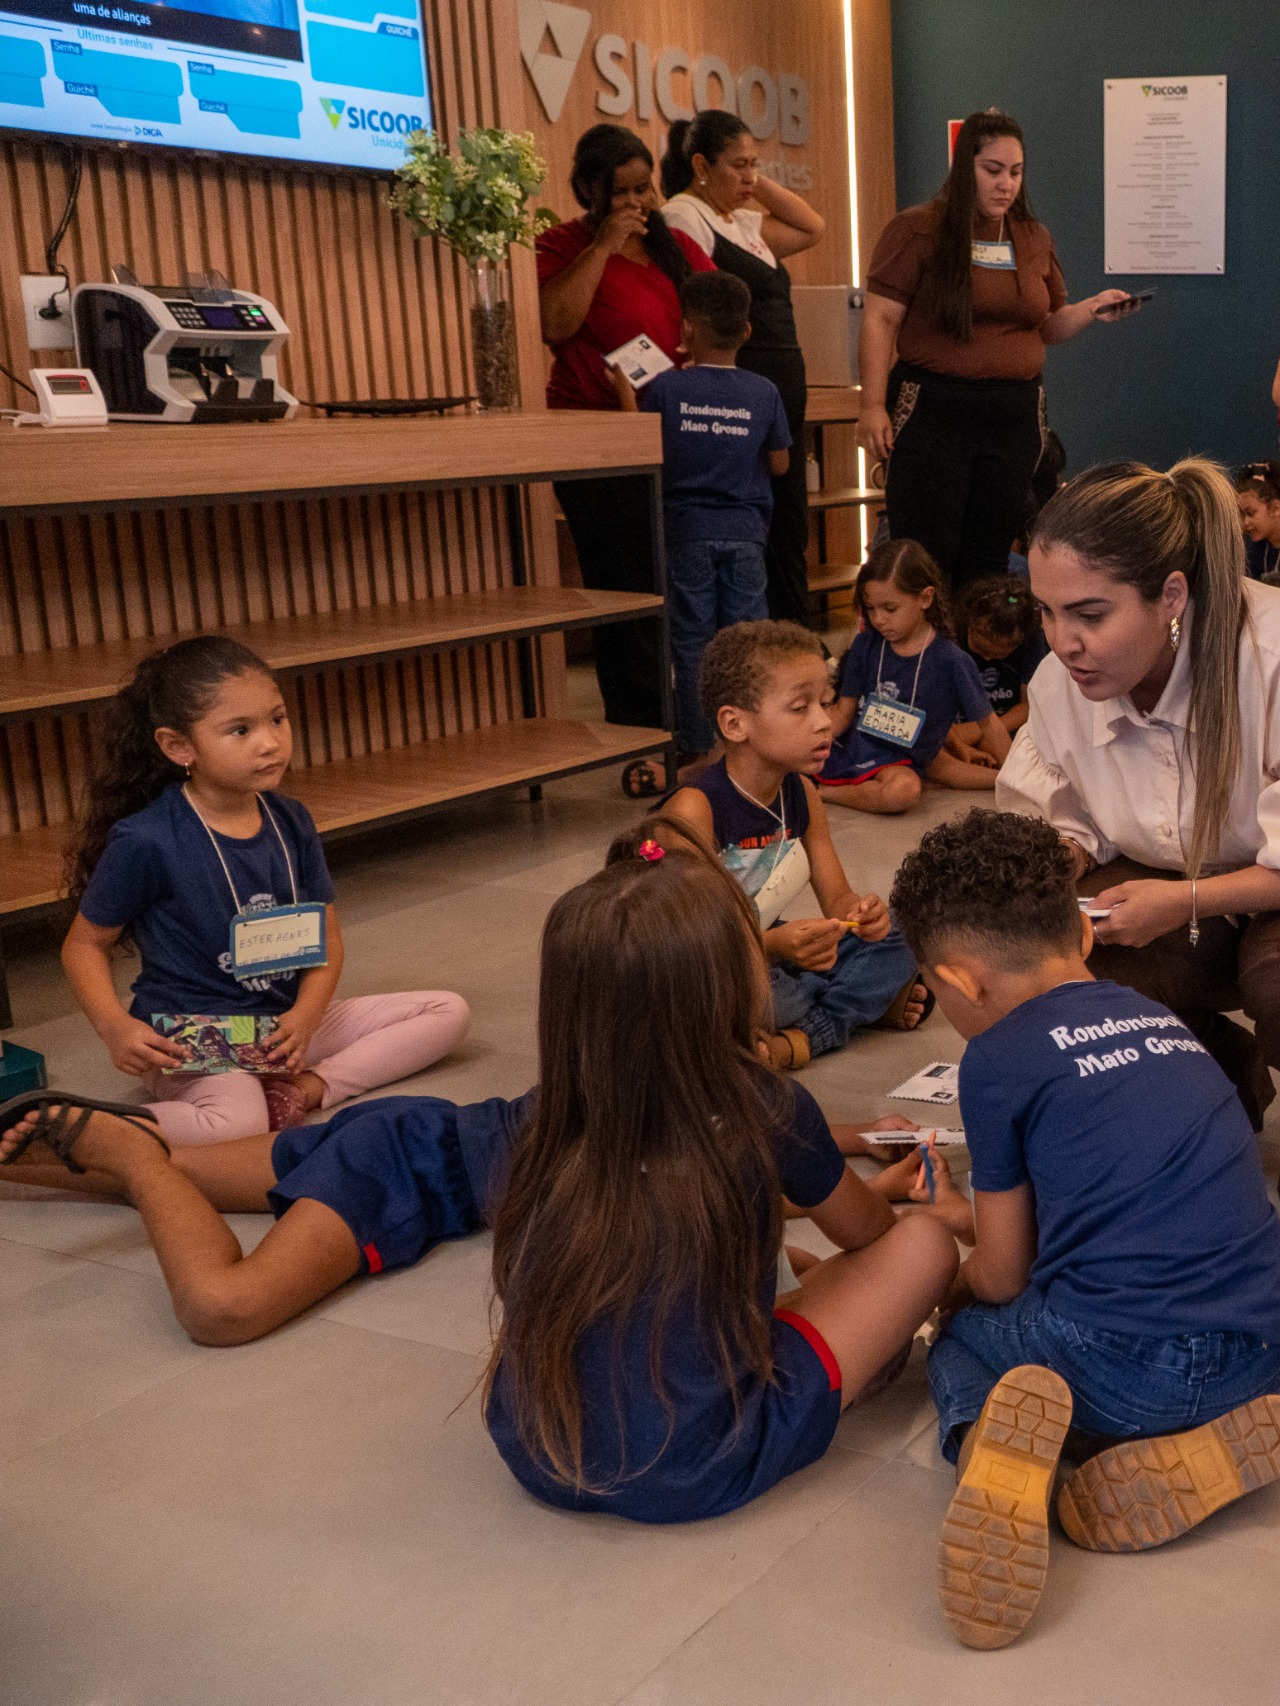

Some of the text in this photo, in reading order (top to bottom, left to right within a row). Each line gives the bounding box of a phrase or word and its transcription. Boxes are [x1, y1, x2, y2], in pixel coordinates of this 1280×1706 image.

[73, 3, 151, 26] uma de alianças
[53, 41, 80, 54] Senha
[119, 37, 154, 50] senhas
[594, 34, 810, 146] SICOOB
[347, 107, 423, 133] SICOOB
[680, 419, 749, 436] Mato Grosso
[874, 708, 905, 726] MARIA
[239, 933, 273, 949] ESTER
[1074, 1047, 1140, 1078] Mato
